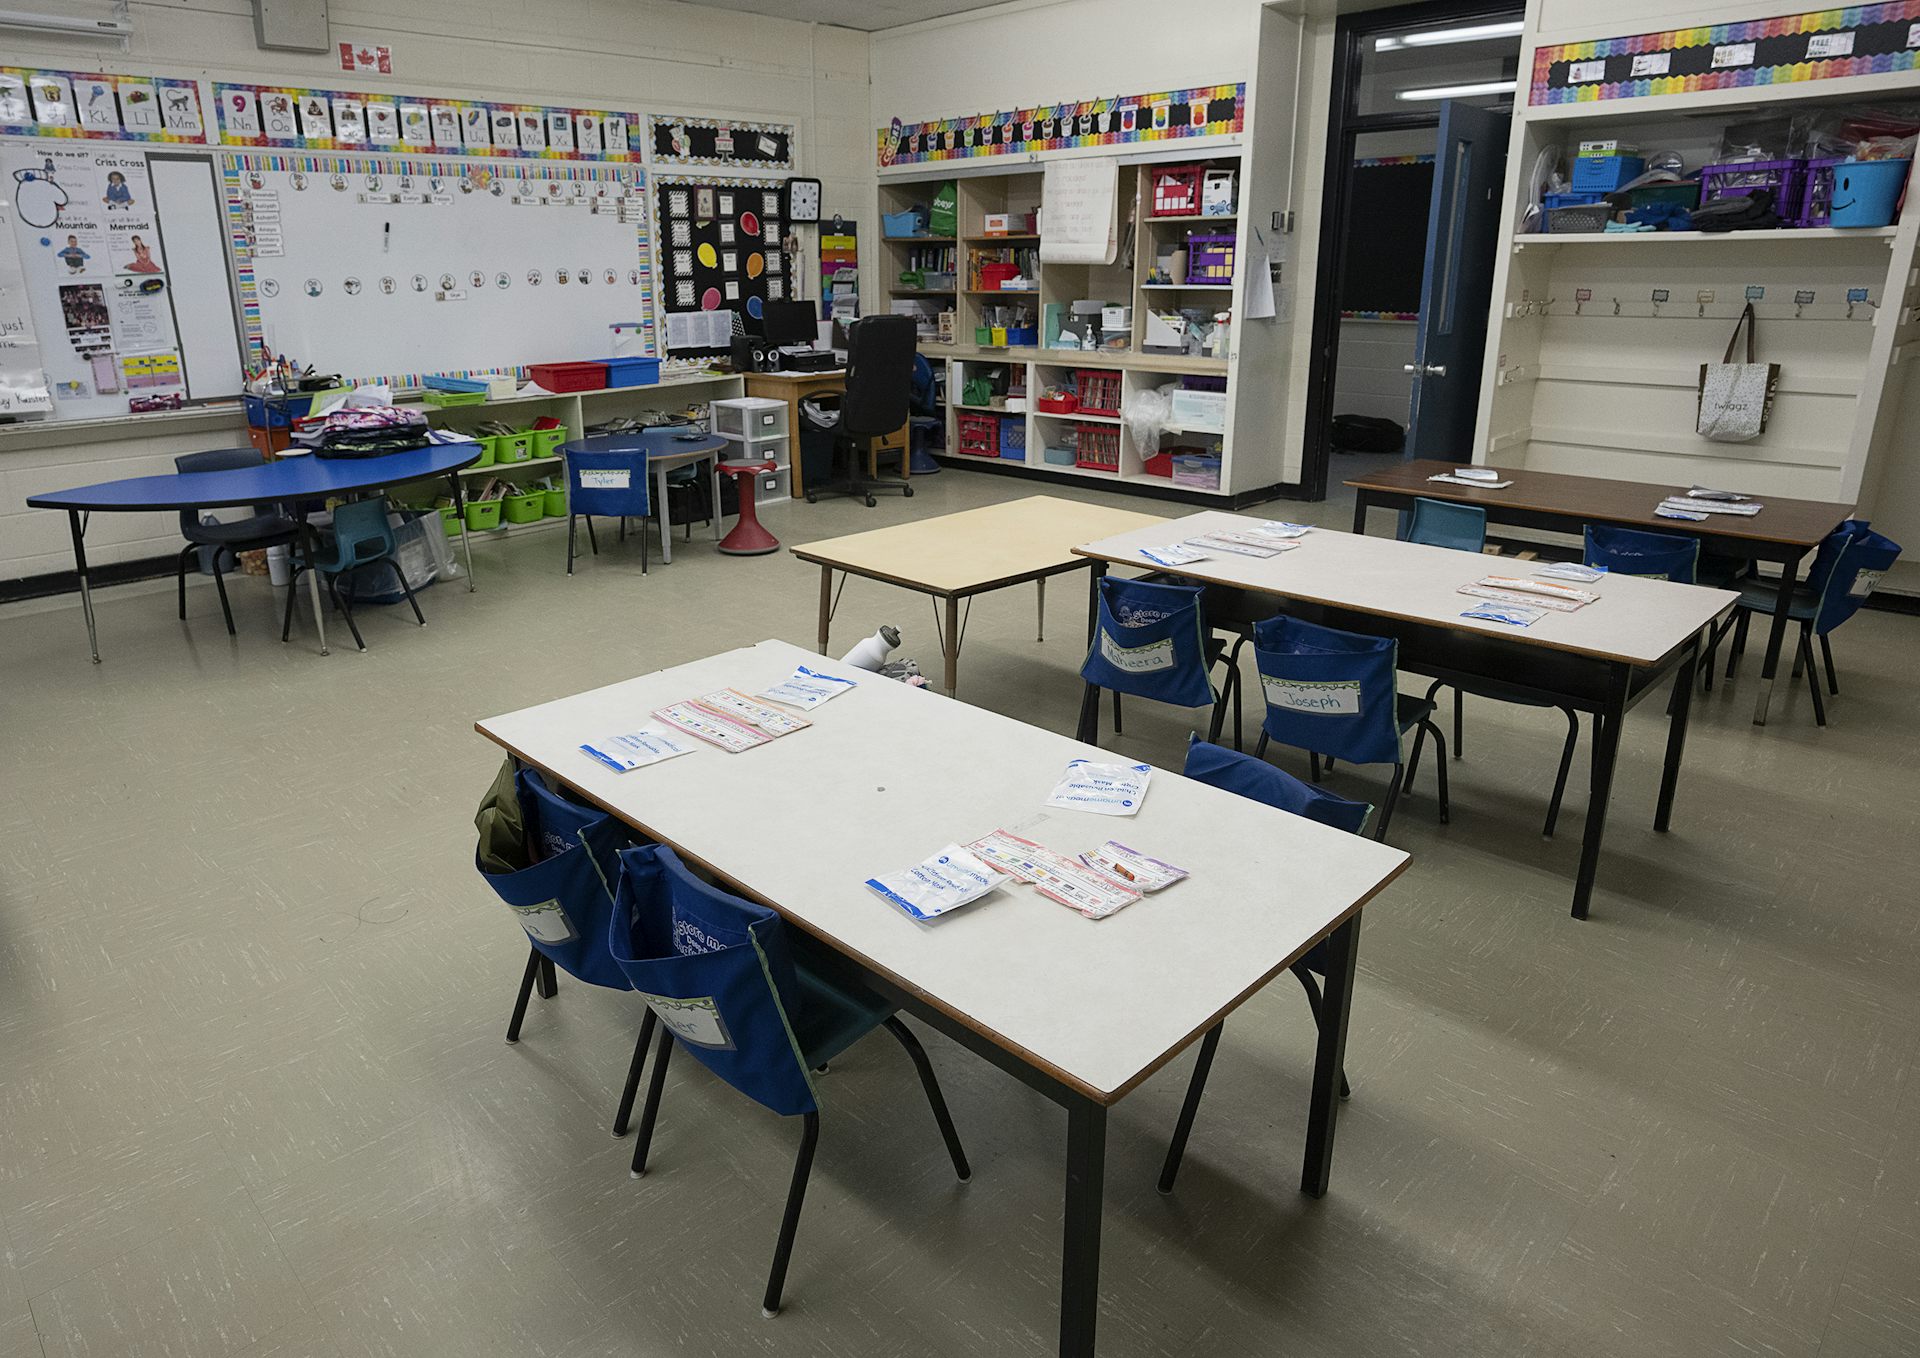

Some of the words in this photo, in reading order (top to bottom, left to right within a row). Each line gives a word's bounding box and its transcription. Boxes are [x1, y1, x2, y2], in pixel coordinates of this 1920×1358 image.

[88, 109, 109, 124] Kk
[134, 111, 149, 125] Ll
[168, 115, 197, 129] Mm
[232, 117, 252, 130] Nn
[271, 118, 290, 132] Oo
[310, 121, 325, 135] Pp
[411, 127, 424, 140] Ss
[441, 129, 453, 142] Tt
[469, 130, 485, 143] Uu
[499, 133, 513, 144] Vv
[522, 133, 543, 146] Ww
[554, 134, 568, 146] Xx
[584, 136, 595, 150] Yy
[610, 138, 622, 150] Zz
[882, 124, 900, 163] COLORS
[95, 158, 117, 167] Criss
[119, 159, 145, 168] Cross
[55, 222, 97, 230] Mountain
[109, 223, 149, 231] Mermaid
[1714, 402, 1748, 412] twiggz
[592, 477, 614, 486] Tyler
[1133, 609, 1160, 619] store
[1283, 691, 1341, 710] Joseph
[677, 920, 705, 943] store
